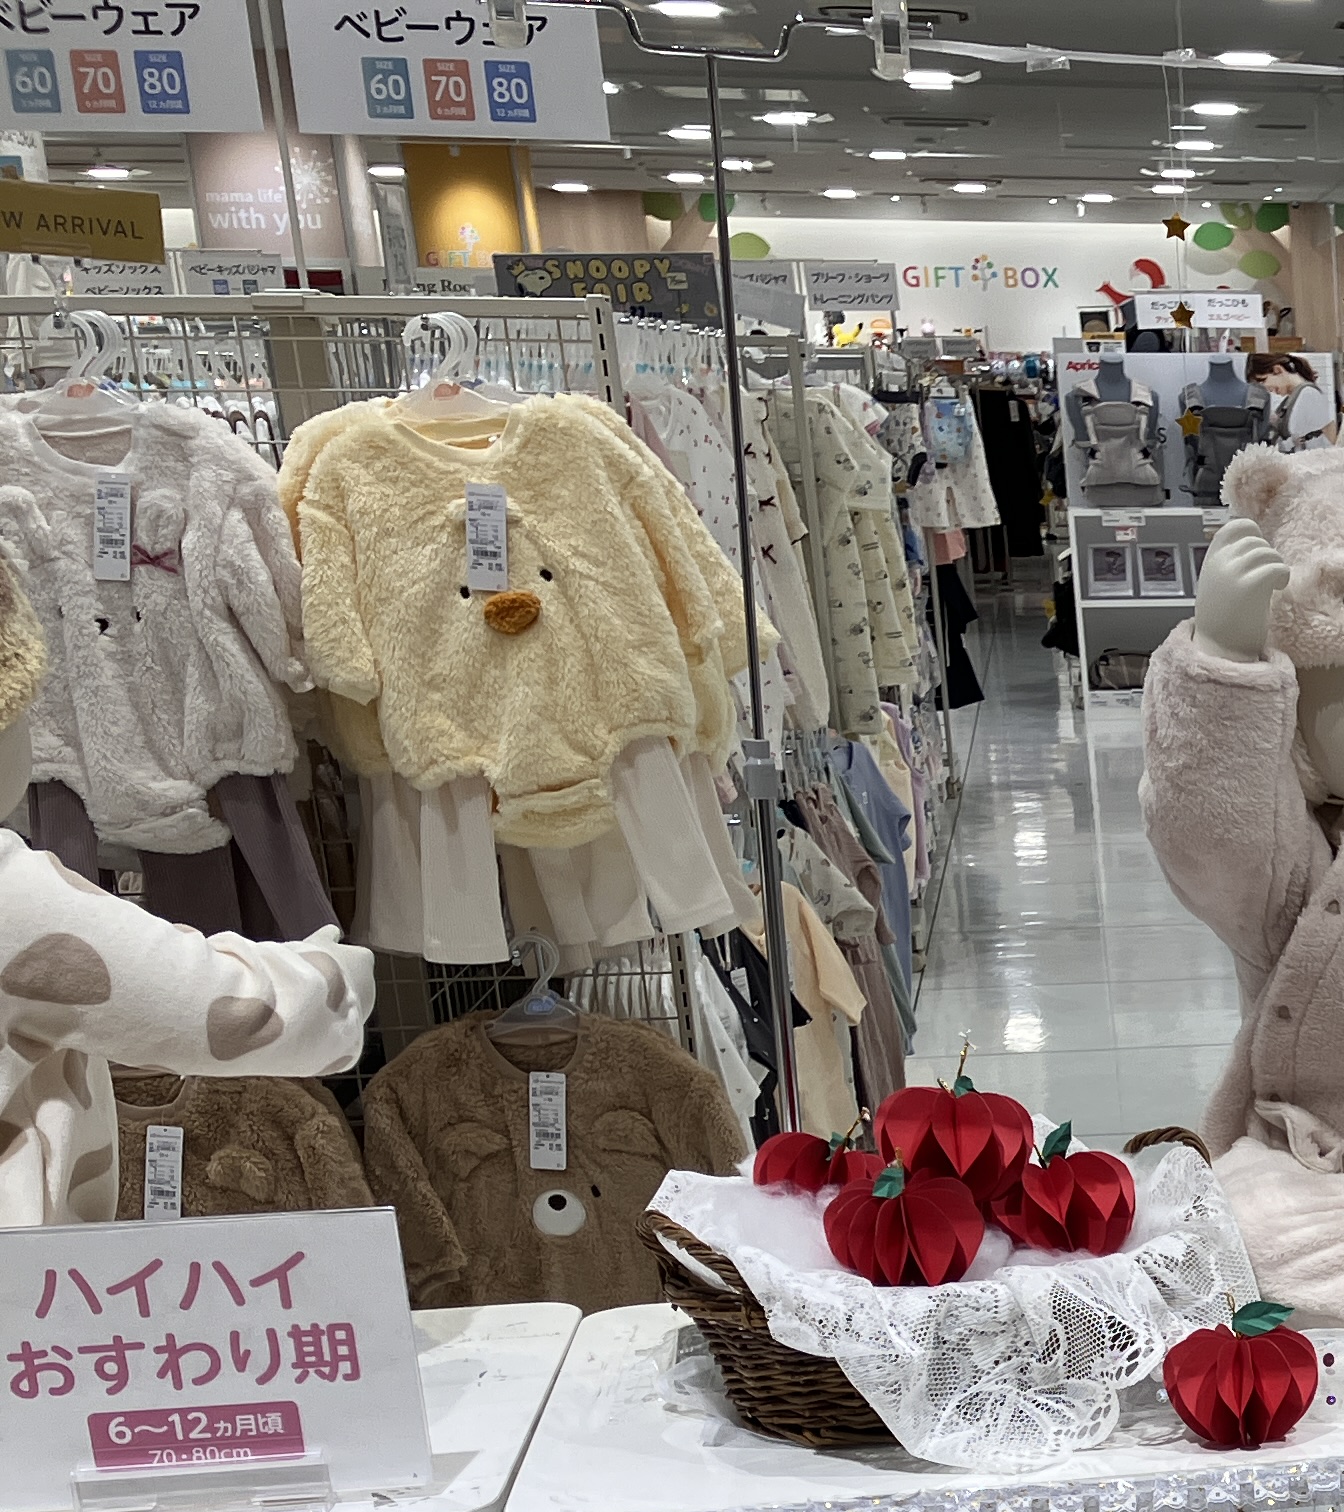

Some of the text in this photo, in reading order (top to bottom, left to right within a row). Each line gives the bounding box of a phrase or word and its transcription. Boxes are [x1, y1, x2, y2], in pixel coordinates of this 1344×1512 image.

[15, 67, 181, 94] 60 70 80
[370, 74, 529, 104] 60 70 80
[206, 191, 253, 203] mama
[36, 212, 145, 240] ARRIVAL
[208, 206, 322, 235] with yu
[545, 258, 672, 280] SNOOPY
[902, 266, 1060, 289] GIFT BOX
[1066, 359, 1099, 372] Apric
[35, 1251, 305, 1318] ハイハイ
[6, 1322, 362, 1400] おすわり期
